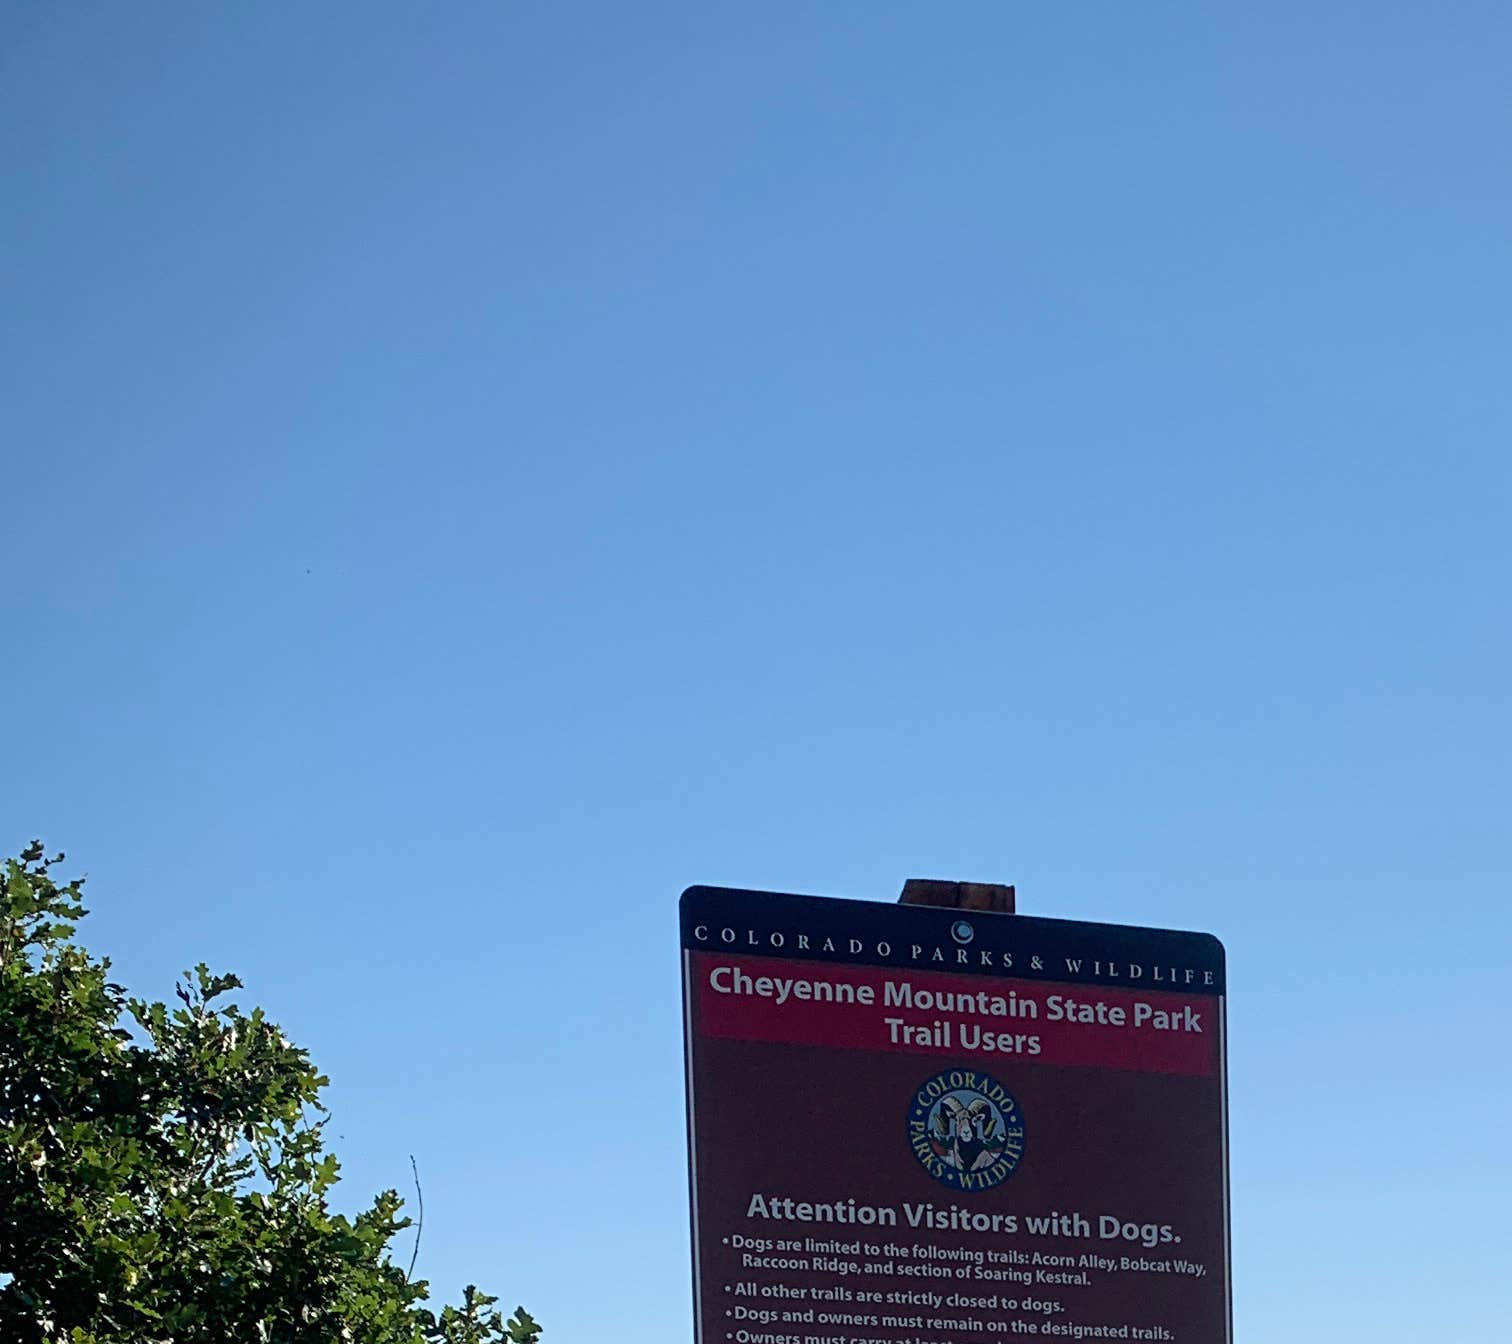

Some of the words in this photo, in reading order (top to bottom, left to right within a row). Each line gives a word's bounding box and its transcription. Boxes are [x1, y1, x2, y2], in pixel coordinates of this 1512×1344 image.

[694, 925, 892, 957] COLORADO
[911, 944, 1013, 968] PARKS
[1030, 955, 1044, 971] &
[1064, 958, 1214, 986] WILDLIFE
[710, 966, 874, 1004] Cheyenne
[884, 981, 1037, 1018] Mountain
[1046, 995, 1126, 1025] State
[1134, 1002, 1202, 1032] Park
[884, 1017, 950, 1047] Trail
[959, 1023, 1040, 1054] Users
[917, 1071, 1015, 1113] COLORADO
[910, 1119, 946, 1178] PARKS
[958, 1126, 1023, 1189] WILDLIFE
[746, 1193, 896, 1225] Attention
[902, 1203, 1017, 1233] Visitors
[1025, 1211, 1090, 1237] with
[1099, 1215, 1181, 1247] Dogs.
[732, 1234, 773, 1253] Dogs
[776, 1240, 801, 1251] are
[805, 1237, 860, 1254] limited
[883, 1242, 909, 1257] the
[912, 1243, 983, 1264] following
[987, 1249, 1029, 1264] trails:
[1031, 1251, 1074, 1267] Acorn
[1078, 1254, 1117, 1272] Alley,
[1120, 1256, 1170, 1272] Bobcat
[1173, 1259, 1206, 1277] Way,
[742, 1253, 808, 1269] Raccoon
[812, 1256, 861, 1275] Ridge,
[864, 1260, 893, 1274] and
[897, 1262, 951, 1277] section
[974, 1266, 1031, 1285] Soaring
[1036, 1269, 1091, 1285] Kestral.
[734, 1282, 756, 1296] All
[761, 1283, 807, 1299] other
[810, 1286, 852, 1301] trails
[856, 1291, 882, 1302] are
[886, 1290, 942, 1308] strictly
[946, 1293, 997, 1308] closed
[1021, 1296, 1064, 1314] dogs.
[734, 1305, 778, 1324] Dogs
[782, 1308, 813, 1322] and
[818, 1313, 878, 1326] owners
[882, 1316, 922, 1328] must
[926, 1316, 982, 1331] remain
[1011, 1319, 1037, 1333] the
[1041, 1320, 1128, 1339] designated
[1132, 1326, 1174, 1340] trails.
[735, 1329, 800, 1344] Owners
